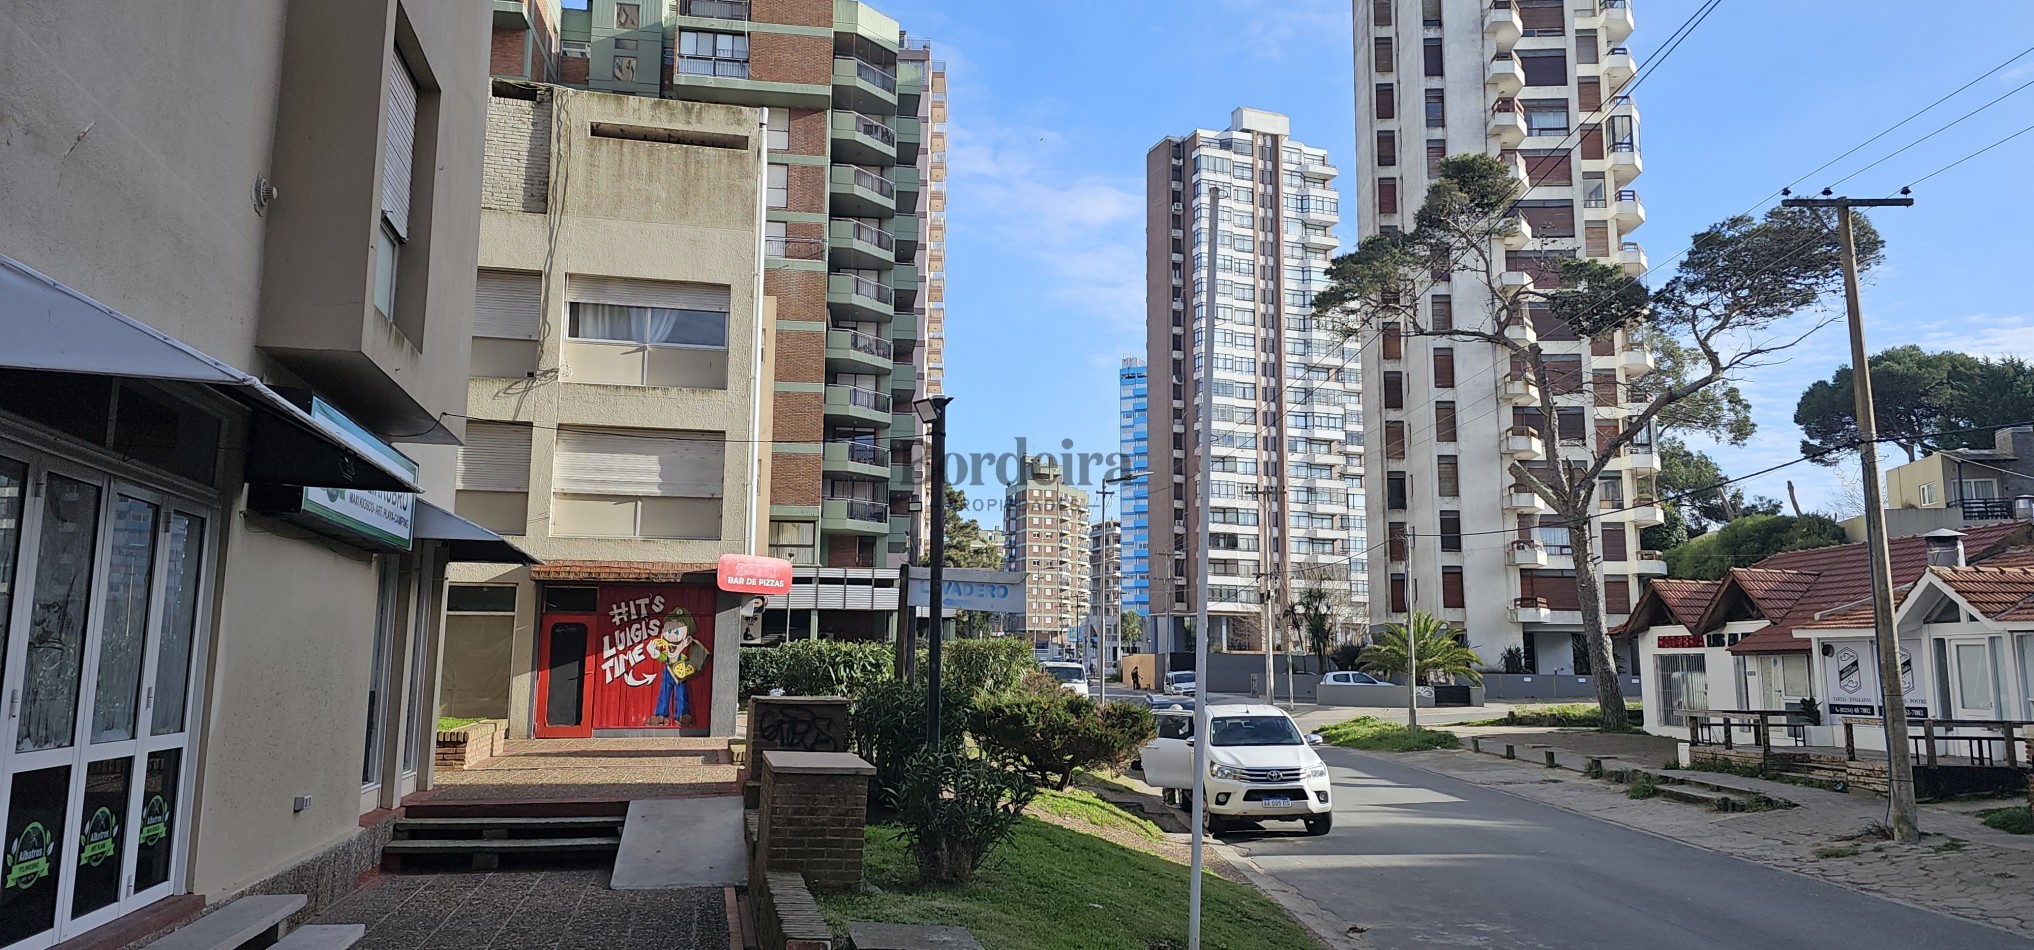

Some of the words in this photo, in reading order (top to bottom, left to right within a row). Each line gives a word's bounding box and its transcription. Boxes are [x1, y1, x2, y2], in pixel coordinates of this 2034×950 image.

[727, 576, 745, 585] BAR
[746, 577, 757, 586] DE
[758, 578, 785, 588] PIZZAS
[919, 580, 1009, 599] LVADERO
[602, 617, 662, 660] LUIGI'S
[600, 643, 646, 685] TIME
[19, 848, 43, 862] Albatros
